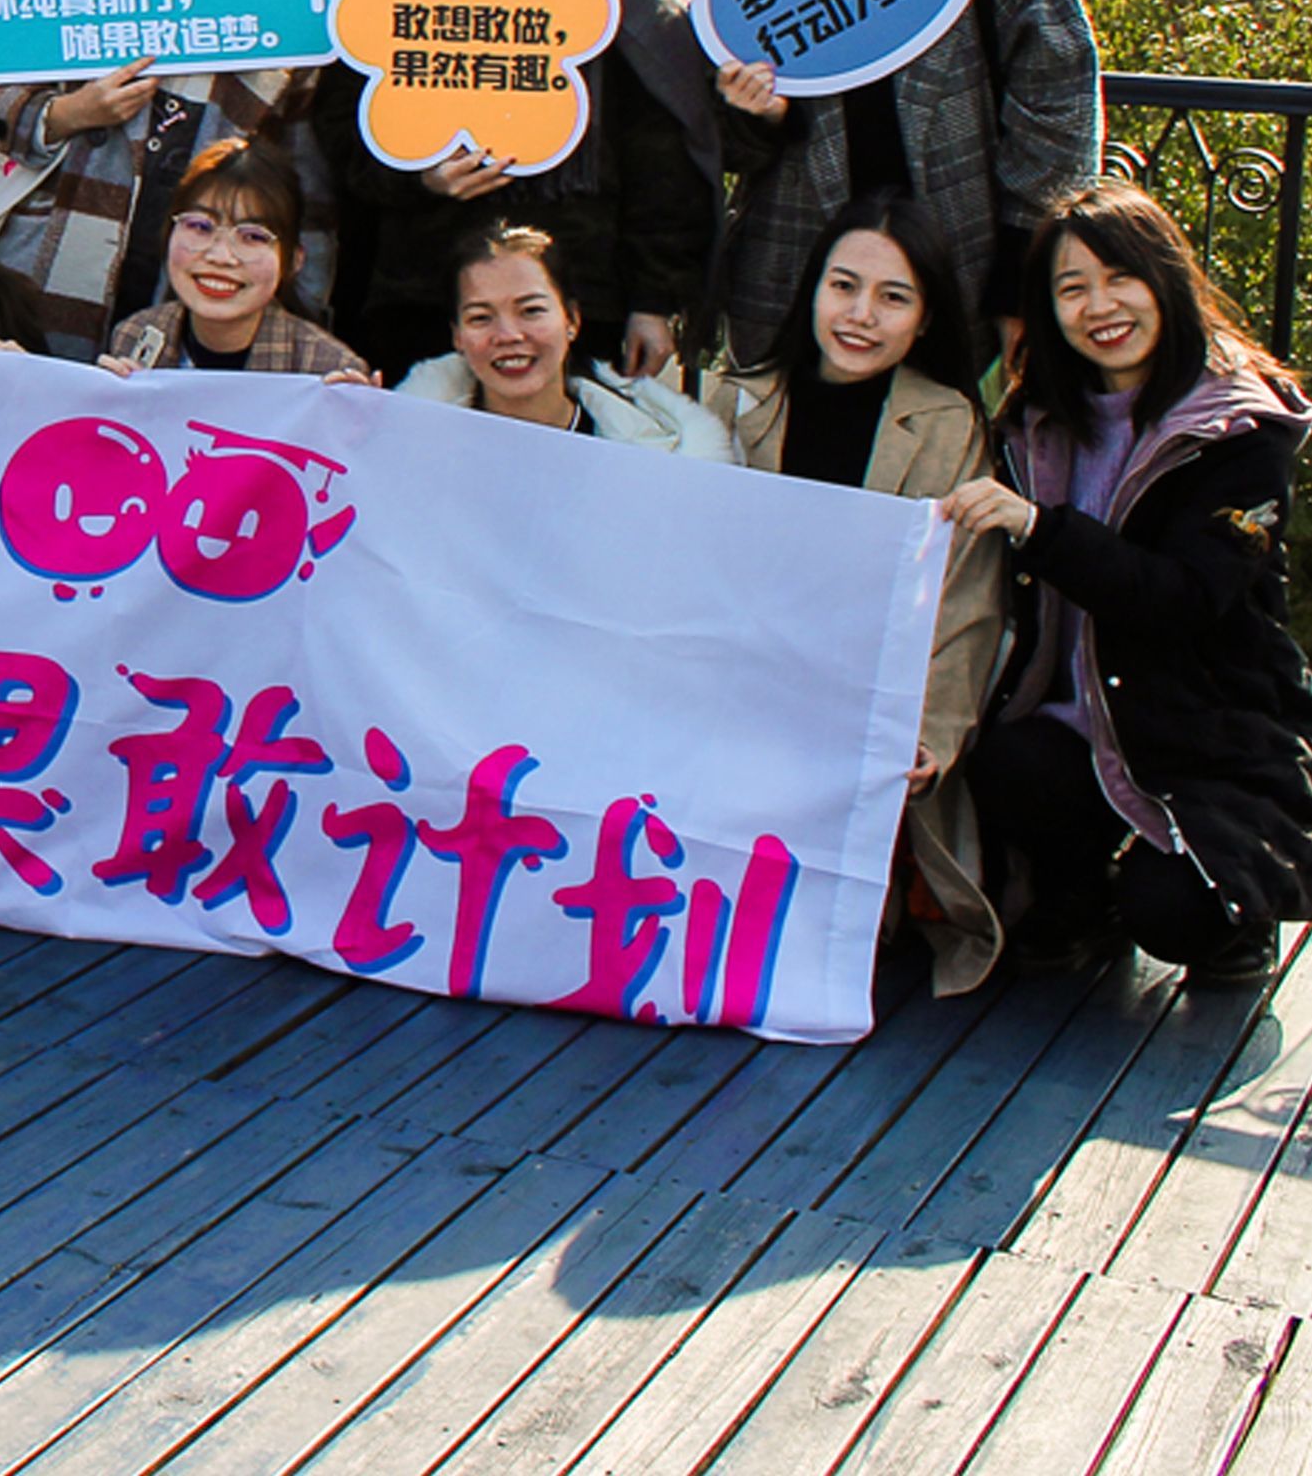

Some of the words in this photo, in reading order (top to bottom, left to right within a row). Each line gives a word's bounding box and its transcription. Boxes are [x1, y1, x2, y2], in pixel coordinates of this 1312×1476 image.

[61, 16, 280, 64] 随果敢追梦。
[392, 3, 569, 46] 敢想敢做，
[390, 51, 570, 92] 果然有趣。
